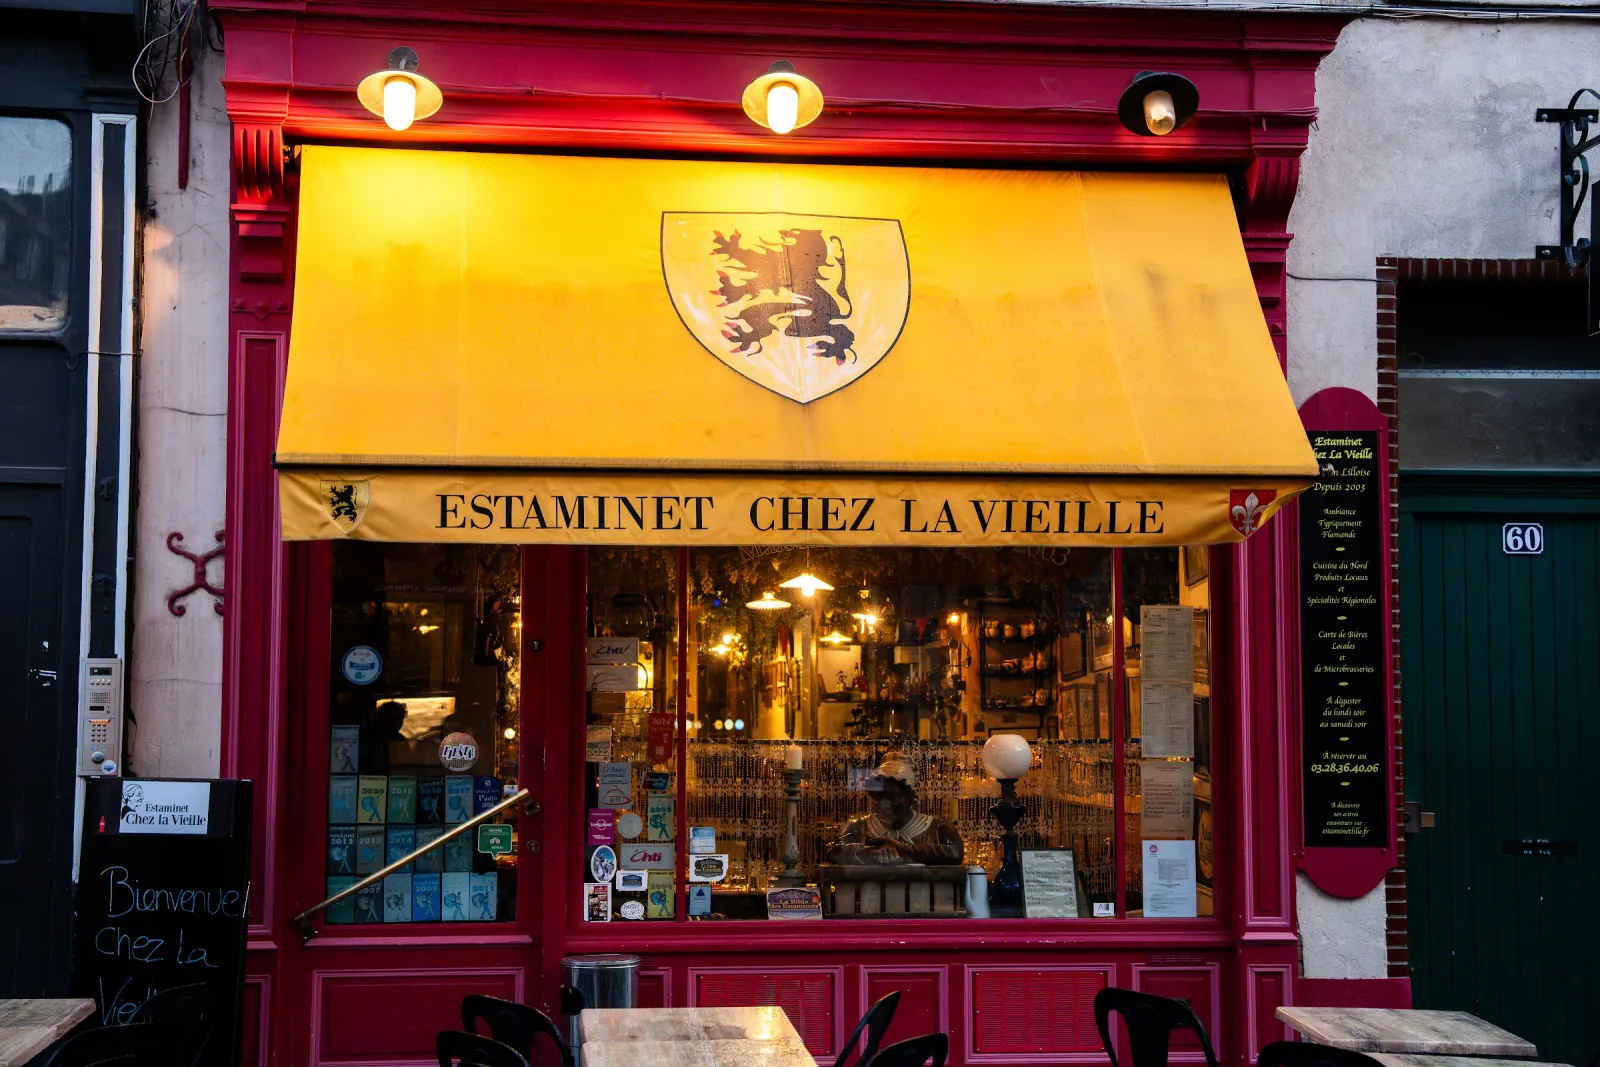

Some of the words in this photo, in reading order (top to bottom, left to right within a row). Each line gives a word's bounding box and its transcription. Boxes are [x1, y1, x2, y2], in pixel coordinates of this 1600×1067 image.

[1314, 436, 1362, 446] Estaminet
[1312, 448, 1327, 459] hez
[1328, 450, 1342, 459] La
[1344, 448, 1372, 460] Vieille
[1341, 466, 1370, 477] Lilloise
[1313, 482, 1342, 495] Depuis
[1344, 484, 1366, 492] 2003
[435, 494, 714, 530] ESTAMINET
[749, 496, 875, 532] CHEZ
[1323, 507, 1356, 516] Ambiance
[1318, 519, 1362, 530] Typiquement
[1322, 530, 1356, 538] Flamande
[1506, 526, 1541, 550] 60
[1312, 562, 1338, 570] Cuisine
[1338, 561, 1348, 570] du
[1350, 560, 1368, 570] Nord
[1314, 572, 1343, 582] Produits
[1344, 572, 1369, 582] Locaux
[1307, 596, 1341, 606] Spécialités
[1342, 596, 1376, 606] Régionales
[1318, 630, 1336, 639] Carte
[1338, 630, 1346, 638] de
[1348, 630, 1368, 638] Bières
[1332, 642, 1356, 650] Locales
[1314, 664, 1322, 673] de
[1322, 664, 1374, 673] Microbrasseries
[1334, 696, 1362, 708] déguster
[1322, 708, 1332, 716] du
[1333, 708, 1352, 716] lundi
[1330, 720, 1352, 728] samedi
[1310, 762, 1379, 774] 03.28.36.40.06
[145, 803, 189, 813] Estaminet
[126, 813, 155, 826] Chez
[158, 814, 168, 826] la
[172, 814, 206, 826] Vieille
[100, 866, 240, 918] Bienvenue
[95, 926, 164, 962] Chez
